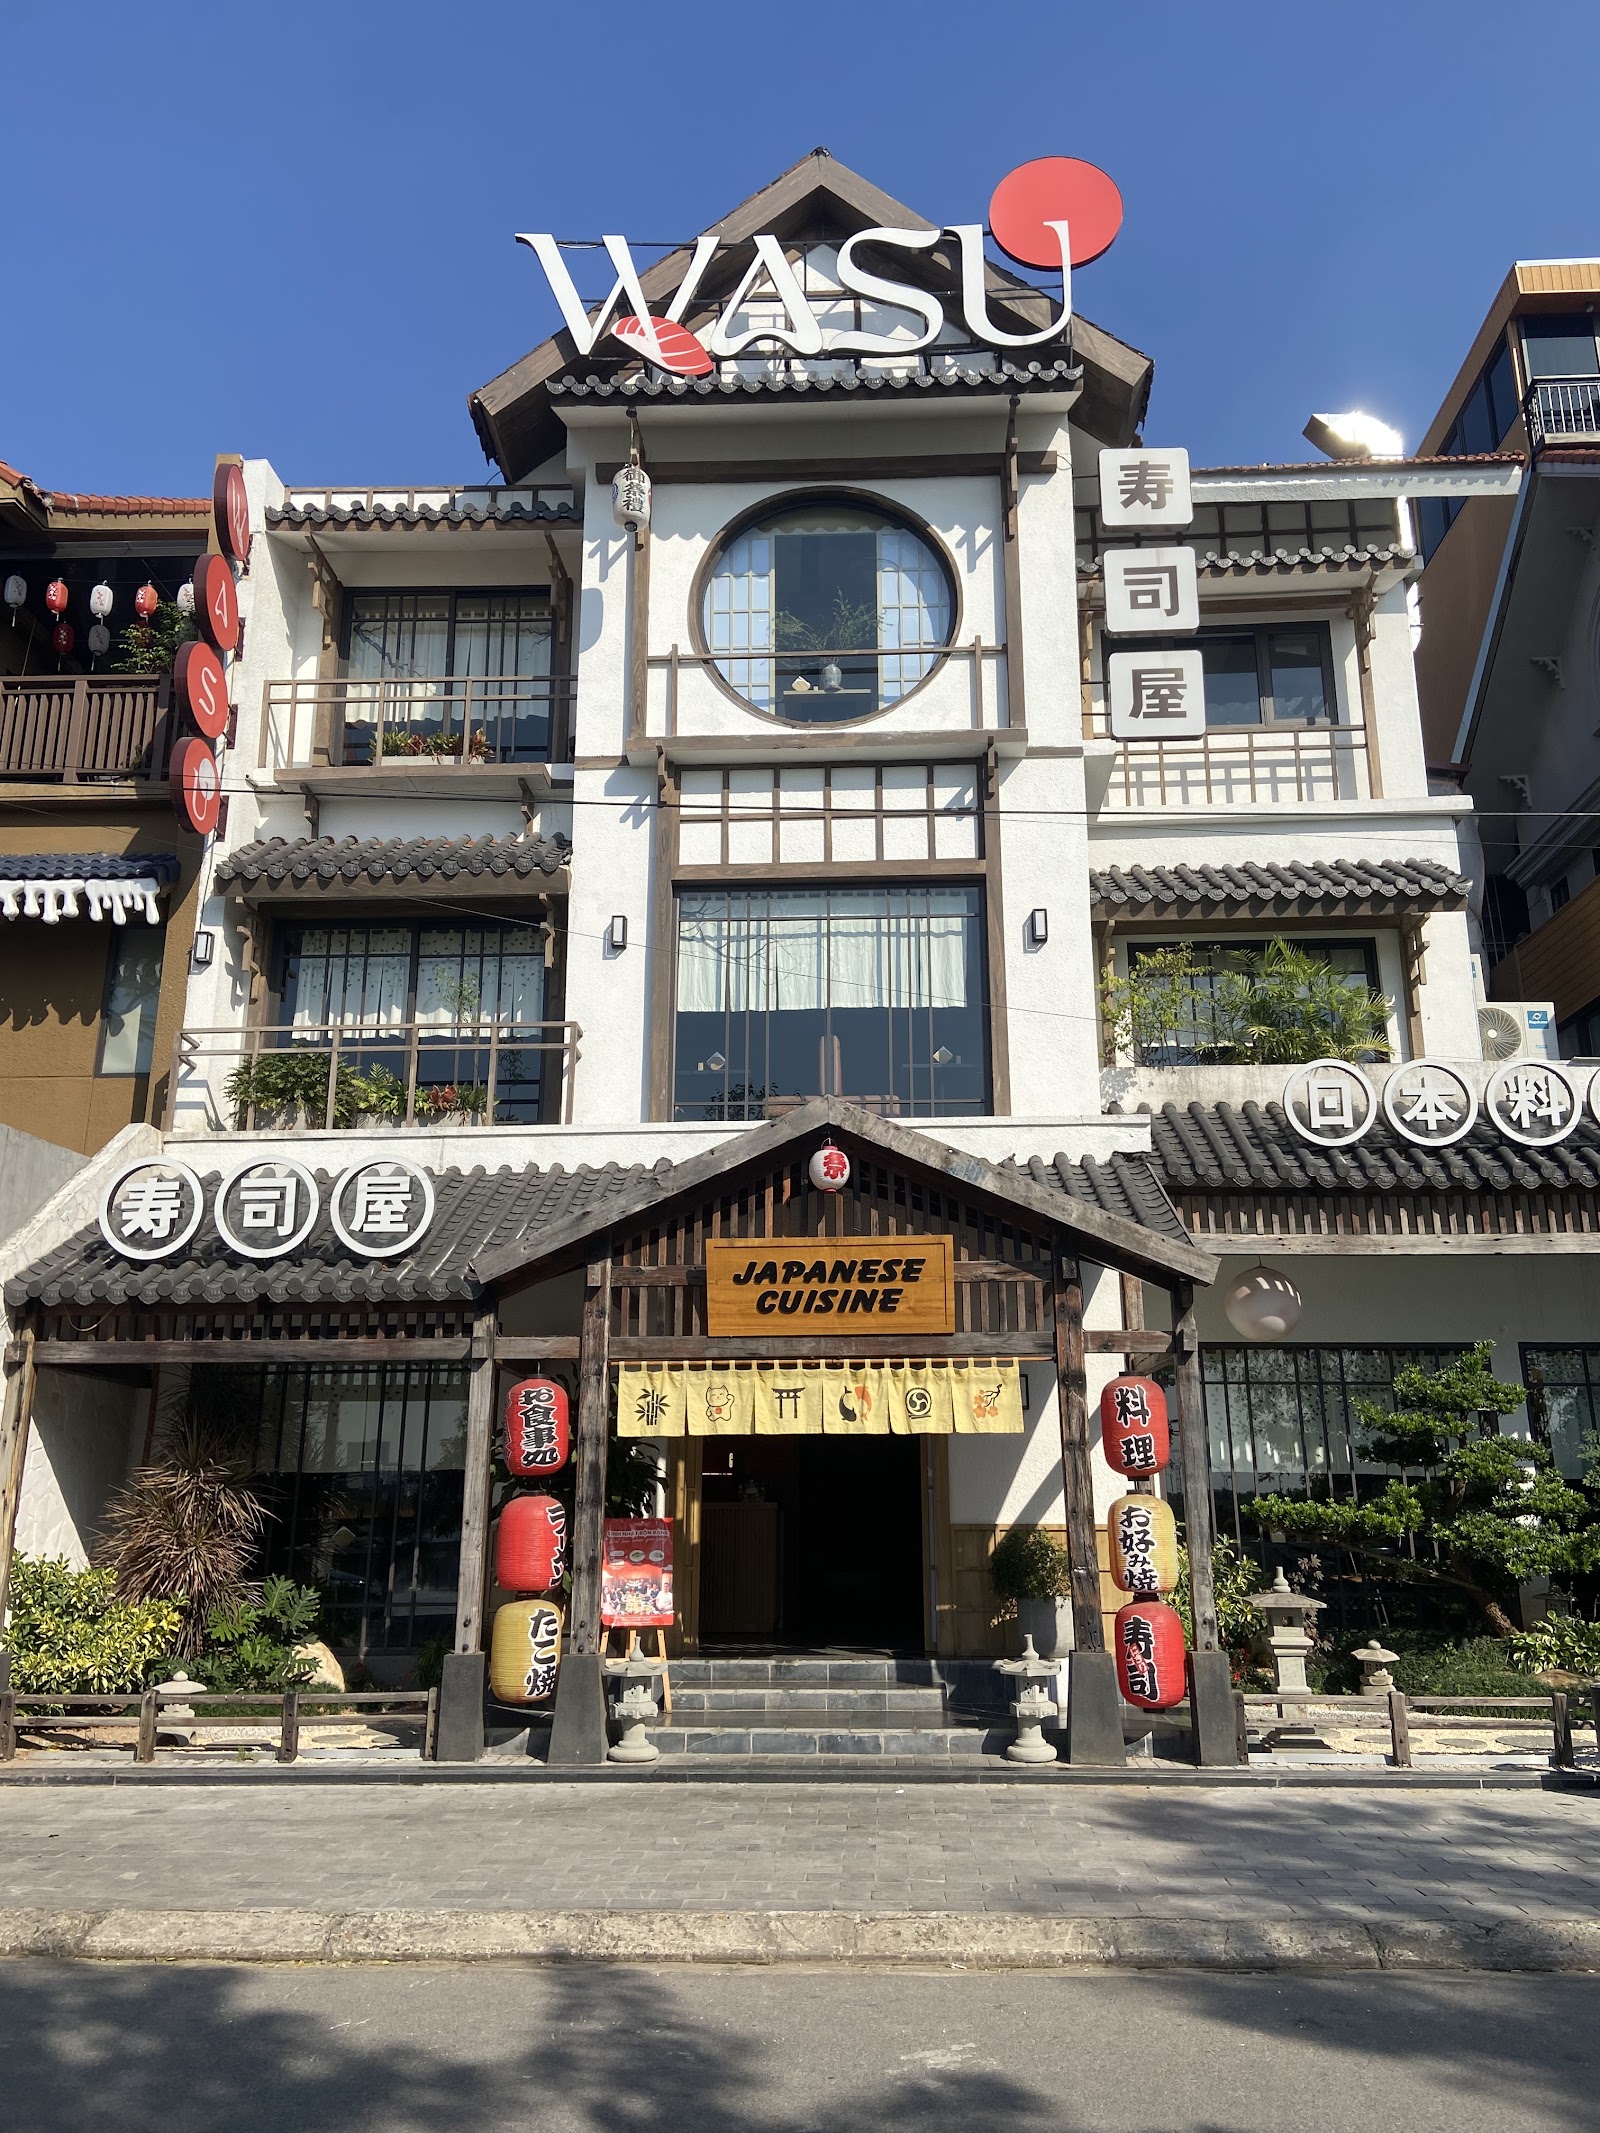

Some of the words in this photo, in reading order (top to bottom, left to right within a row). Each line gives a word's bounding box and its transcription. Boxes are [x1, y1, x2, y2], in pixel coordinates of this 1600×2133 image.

[515, 220, 1075, 374] WASU
[1117, 460, 1189, 720] 寿司屋
[120, 1175, 413, 1239] 寿司屋
[732, 1258, 927, 1287] JAPANESE
[755, 1288, 905, 1315] CUISINE
[1115, 1384, 1157, 1470] 料理
[1118, 1504, 1159, 1591] お好み焼
[1124, 1616, 1160, 1702] 寿司
